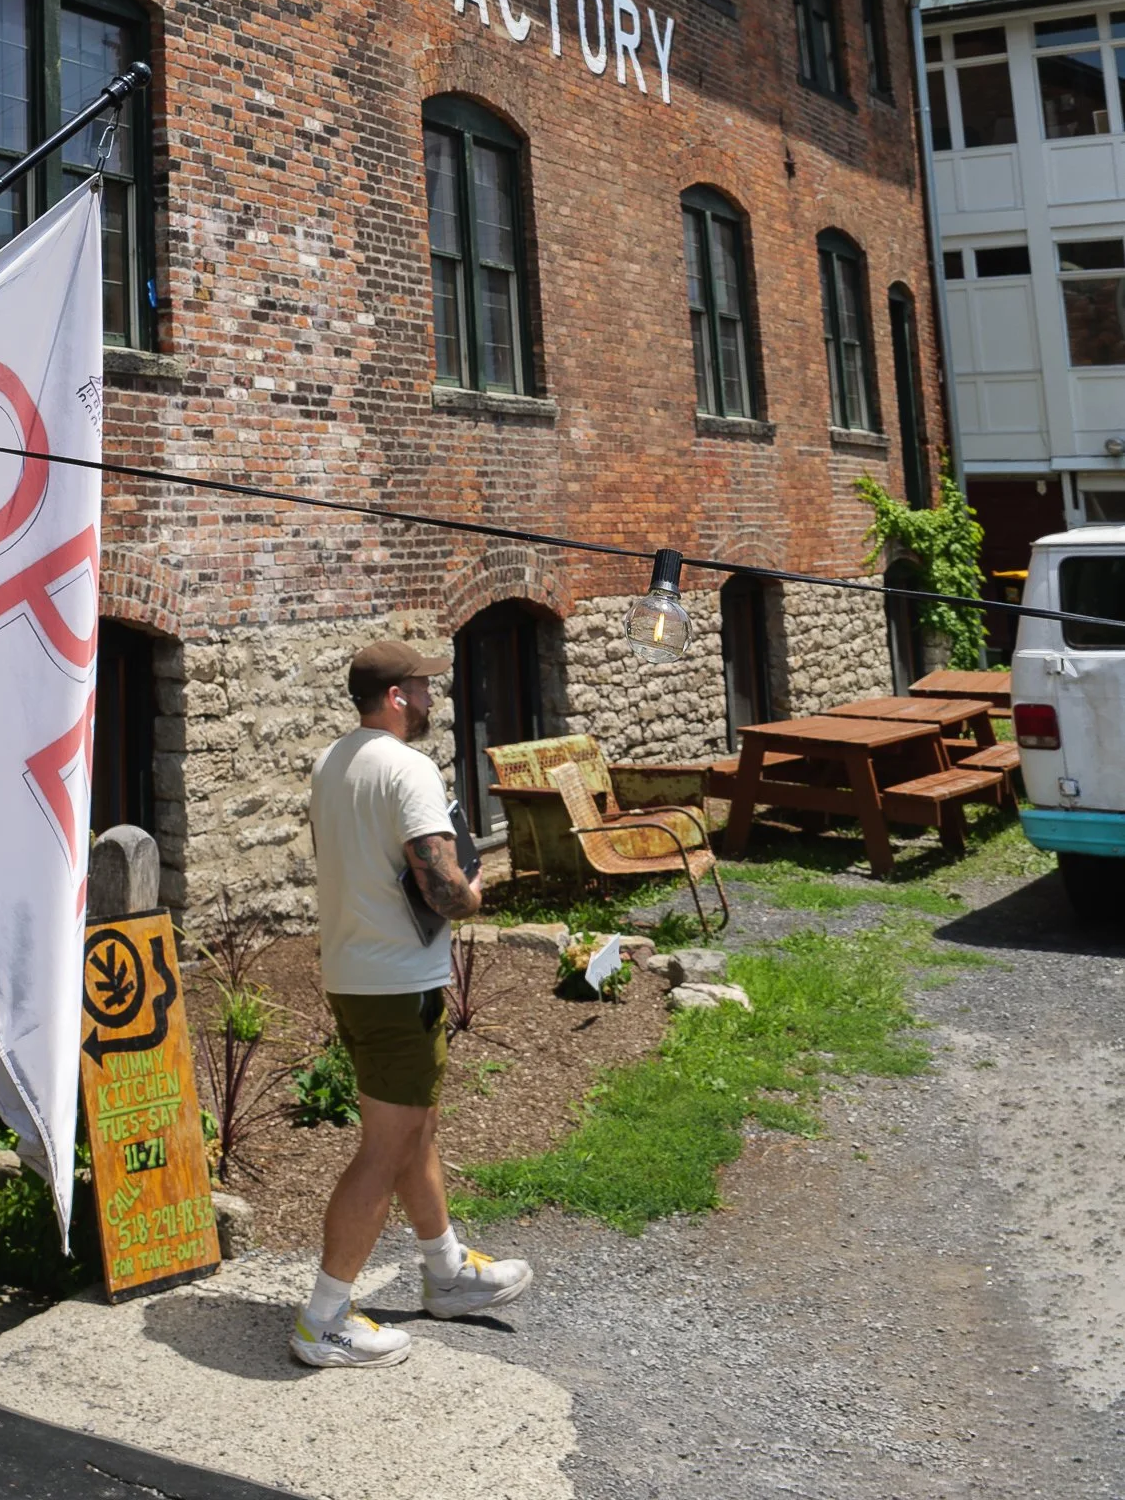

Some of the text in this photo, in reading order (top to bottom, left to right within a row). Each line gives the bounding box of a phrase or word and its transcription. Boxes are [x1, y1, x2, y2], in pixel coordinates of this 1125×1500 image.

[107, 1047, 164, 1082] YUMMY
[97, 1067, 180, 1113] KITCHEN
[97, 1103, 180, 1143] TUES-SAT
[124, 1136, 165, 1173] 11-7!
[112, 1236, 206, 1279] FOR TAKE-OUT!
[321, 1331, 352, 1349] HOKA
